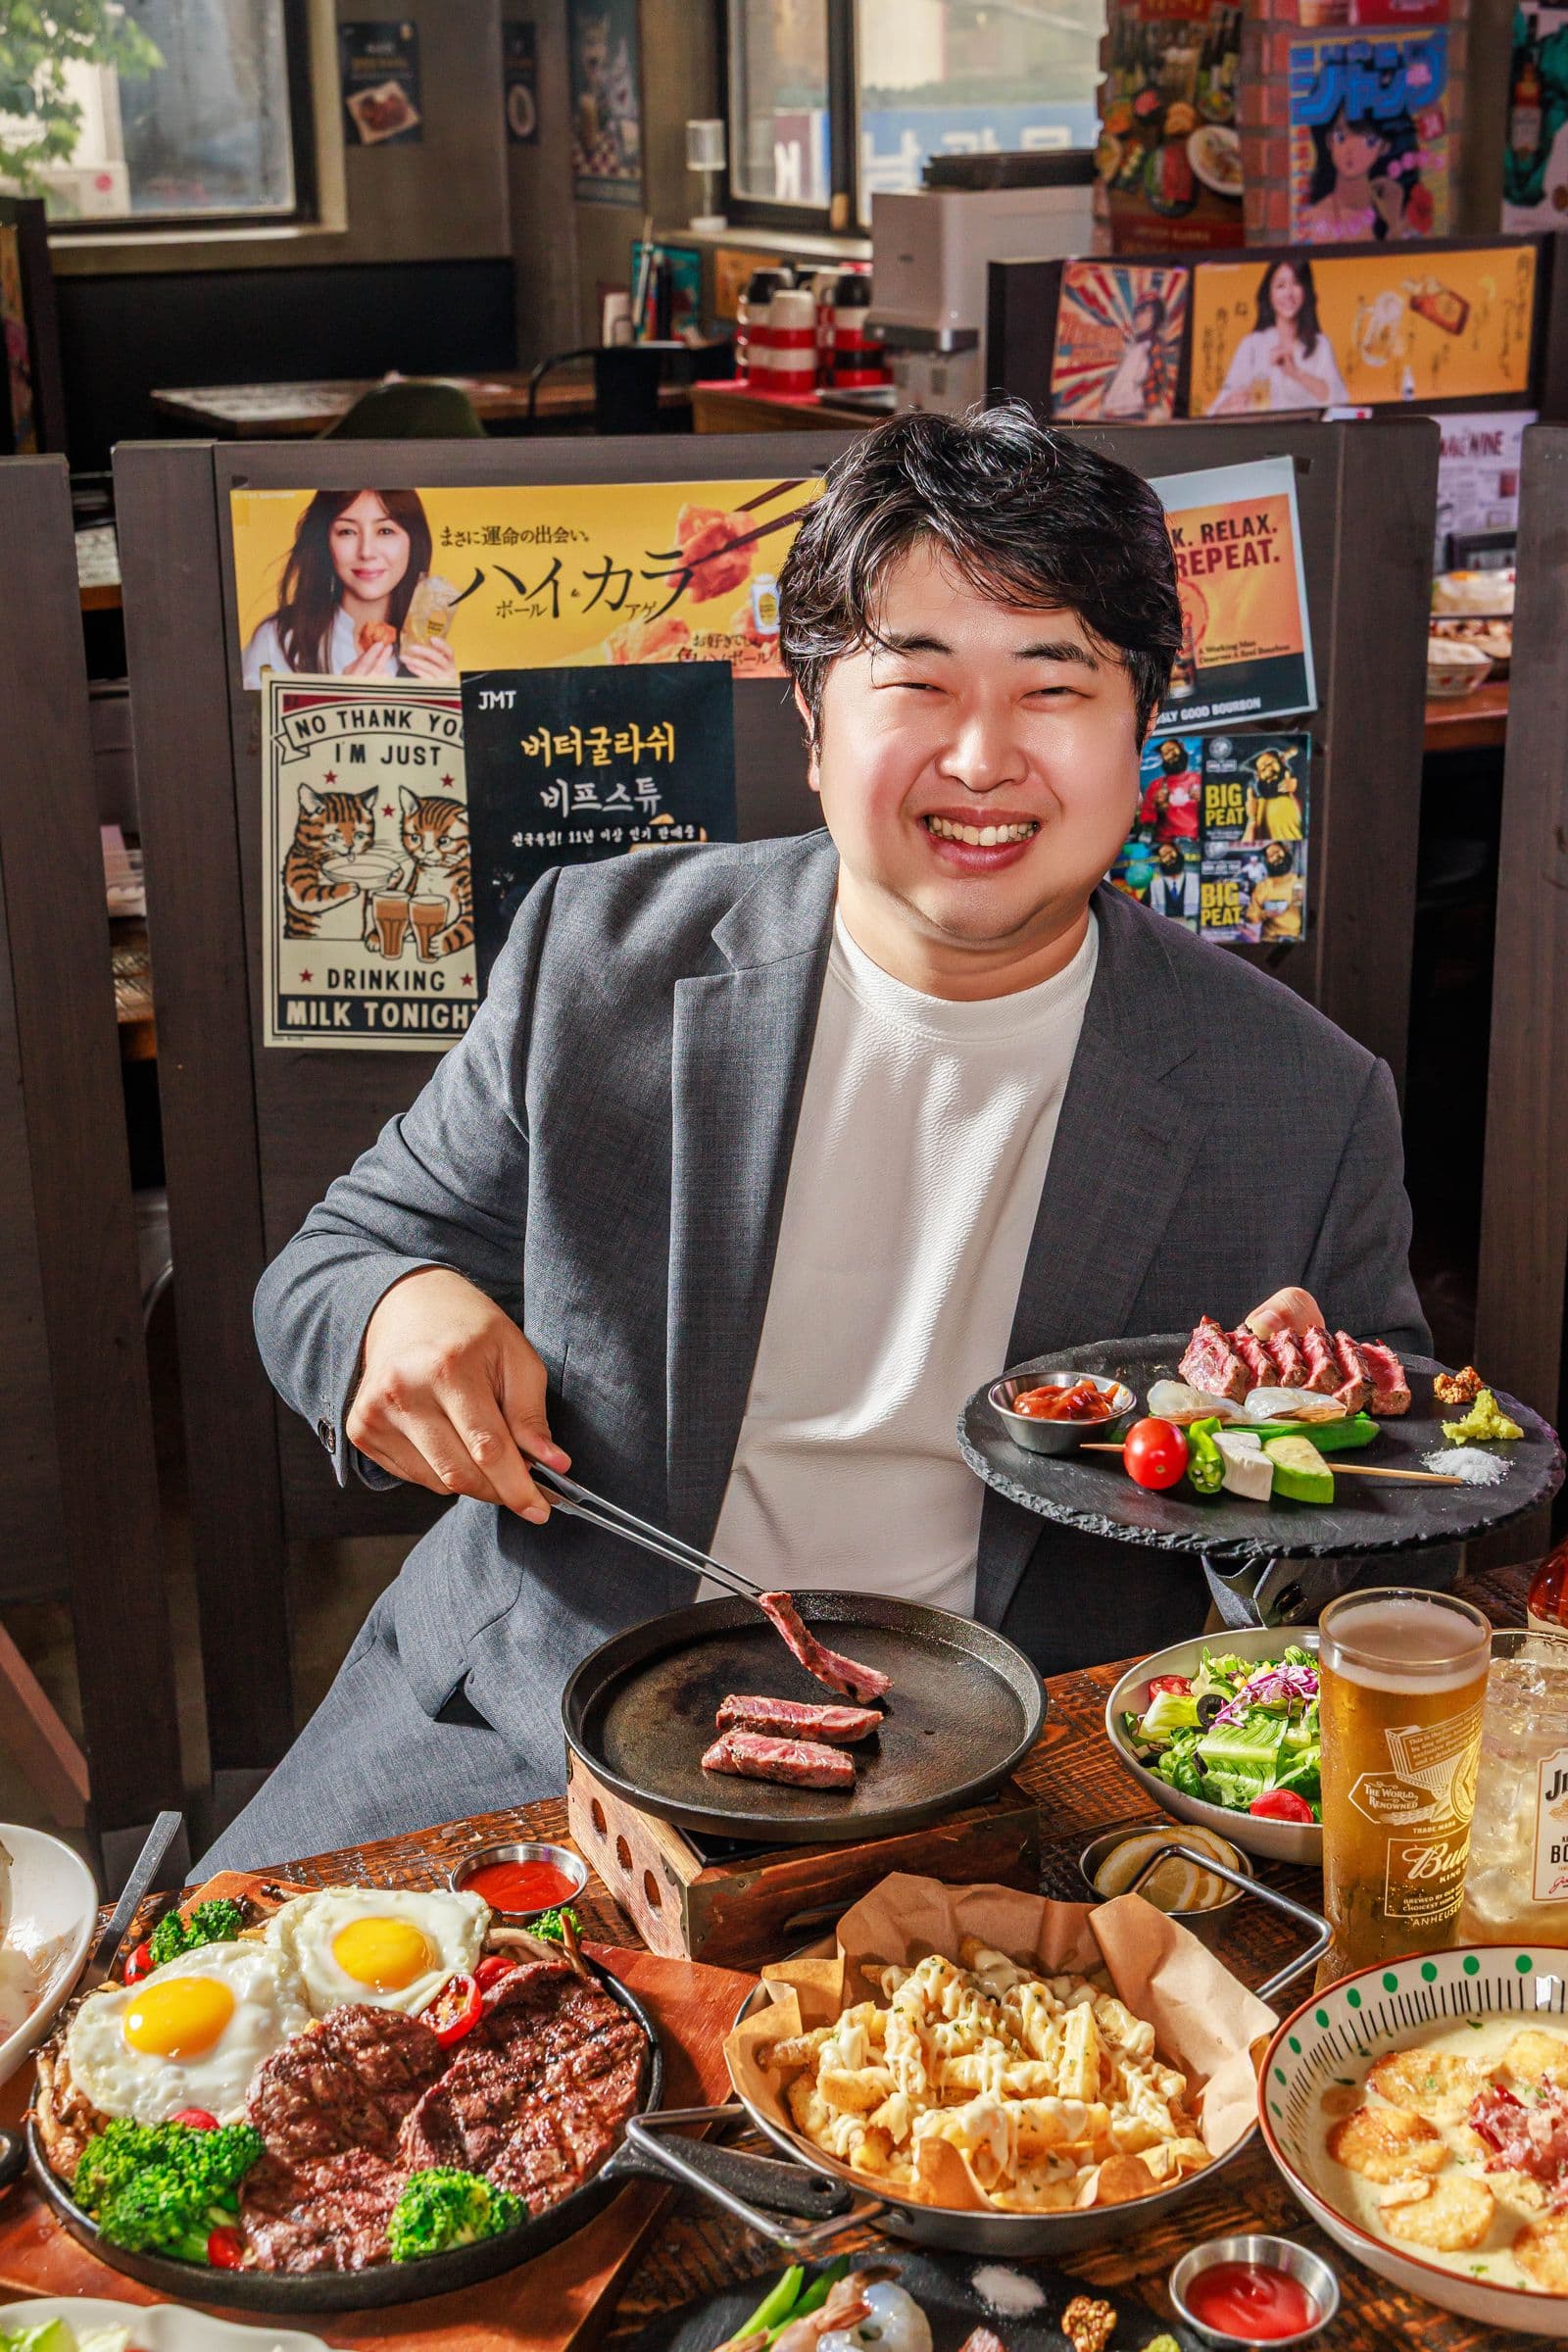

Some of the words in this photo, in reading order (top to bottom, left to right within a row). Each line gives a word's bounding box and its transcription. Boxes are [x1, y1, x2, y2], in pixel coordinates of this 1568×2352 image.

[441, 525, 590, 547] まさに運命の出会い。
[1200, 514, 1278, 545] RELAX.
[1176, 539, 1281, 577] REPEAT.
[478, 690, 517, 710] JMT
[1181, 705, 1209, 720] GOOD
[1211, 697, 1262, 715] BOURBON
[295, 715, 326, 738] NO
[337, 710, 413, 729] THANK
[428, 713, 464, 741] YO
[380, 746, 441, 765] JUST
[520, 721, 675, 767] 버터굴라쉬
[540, 776, 662, 818] 비프스튜
[1204, 783, 1243, 809] BIG
[1205, 808, 1245, 827] PEAT
[1200, 882, 1239, 908] BIG
[1200, 906, 1243, 926] PEAT
[327, 968, 445, 992] DRINKING
[286, 1000, 352, 1028] MILK
[1364, 1784, 1380, 1797] THE
[1382, 1787, 1418, 1801] WORLD
[1369, 1796, 1418, 1810] RENOWNED
[1438, 1821, 1456, 1830] MARK
[1439, 1868, 1461, 1884] KING
